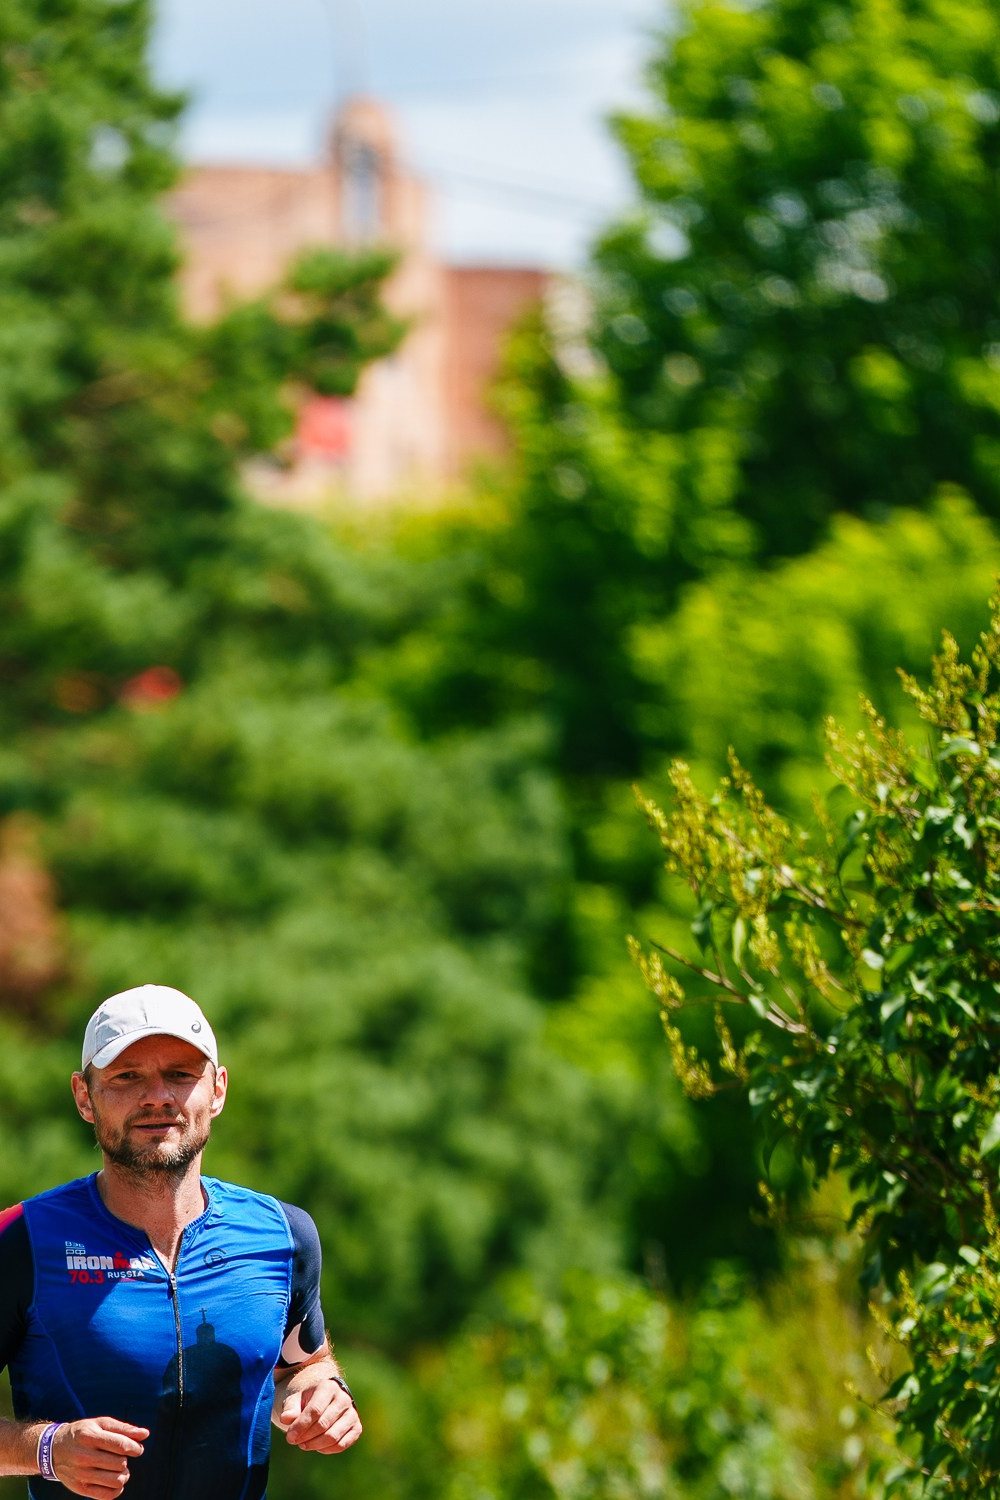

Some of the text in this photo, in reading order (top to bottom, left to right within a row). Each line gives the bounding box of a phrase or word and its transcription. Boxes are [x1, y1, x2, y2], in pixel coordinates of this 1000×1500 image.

[66, 1251, 157, 1270] IRONMAN
[68, 1270, 145, 1284] 70.3 RUSSIA
